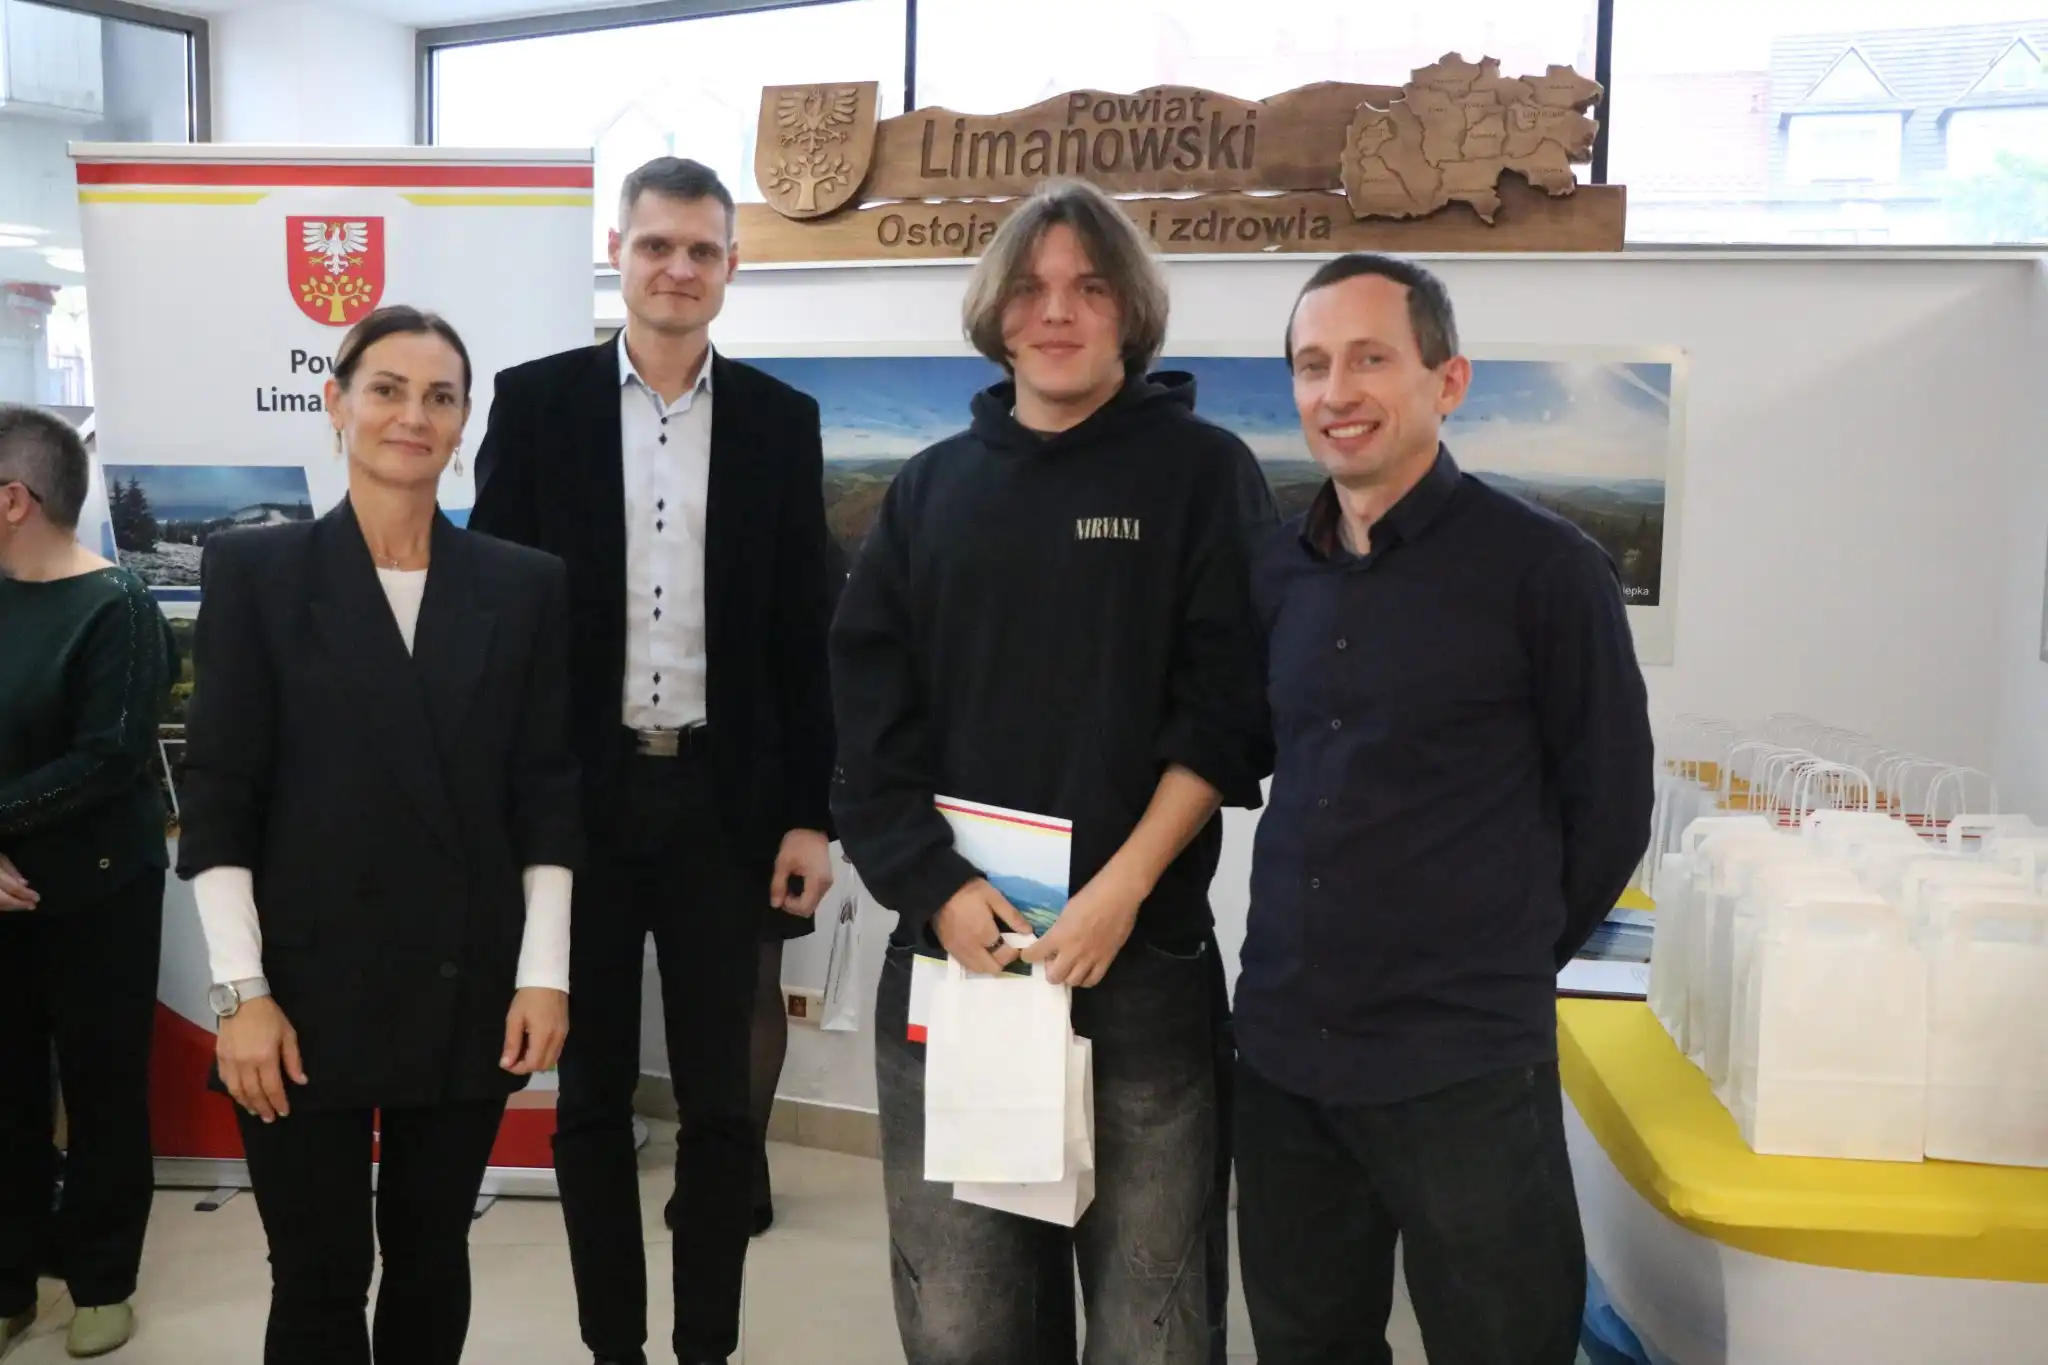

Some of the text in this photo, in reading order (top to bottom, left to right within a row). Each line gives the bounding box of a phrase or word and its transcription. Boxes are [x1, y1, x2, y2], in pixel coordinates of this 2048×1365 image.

[1067, 90, 1205, 125] Powiat
[920, 109, 1257, 179] Limanowski
[877, 212, 998, 254] Ostoja
[1168, 207, 1332, 243] zdrowia
[256, 386, 329, 412] Lima
[1075, 516, 1140, 541] NIRVANA
